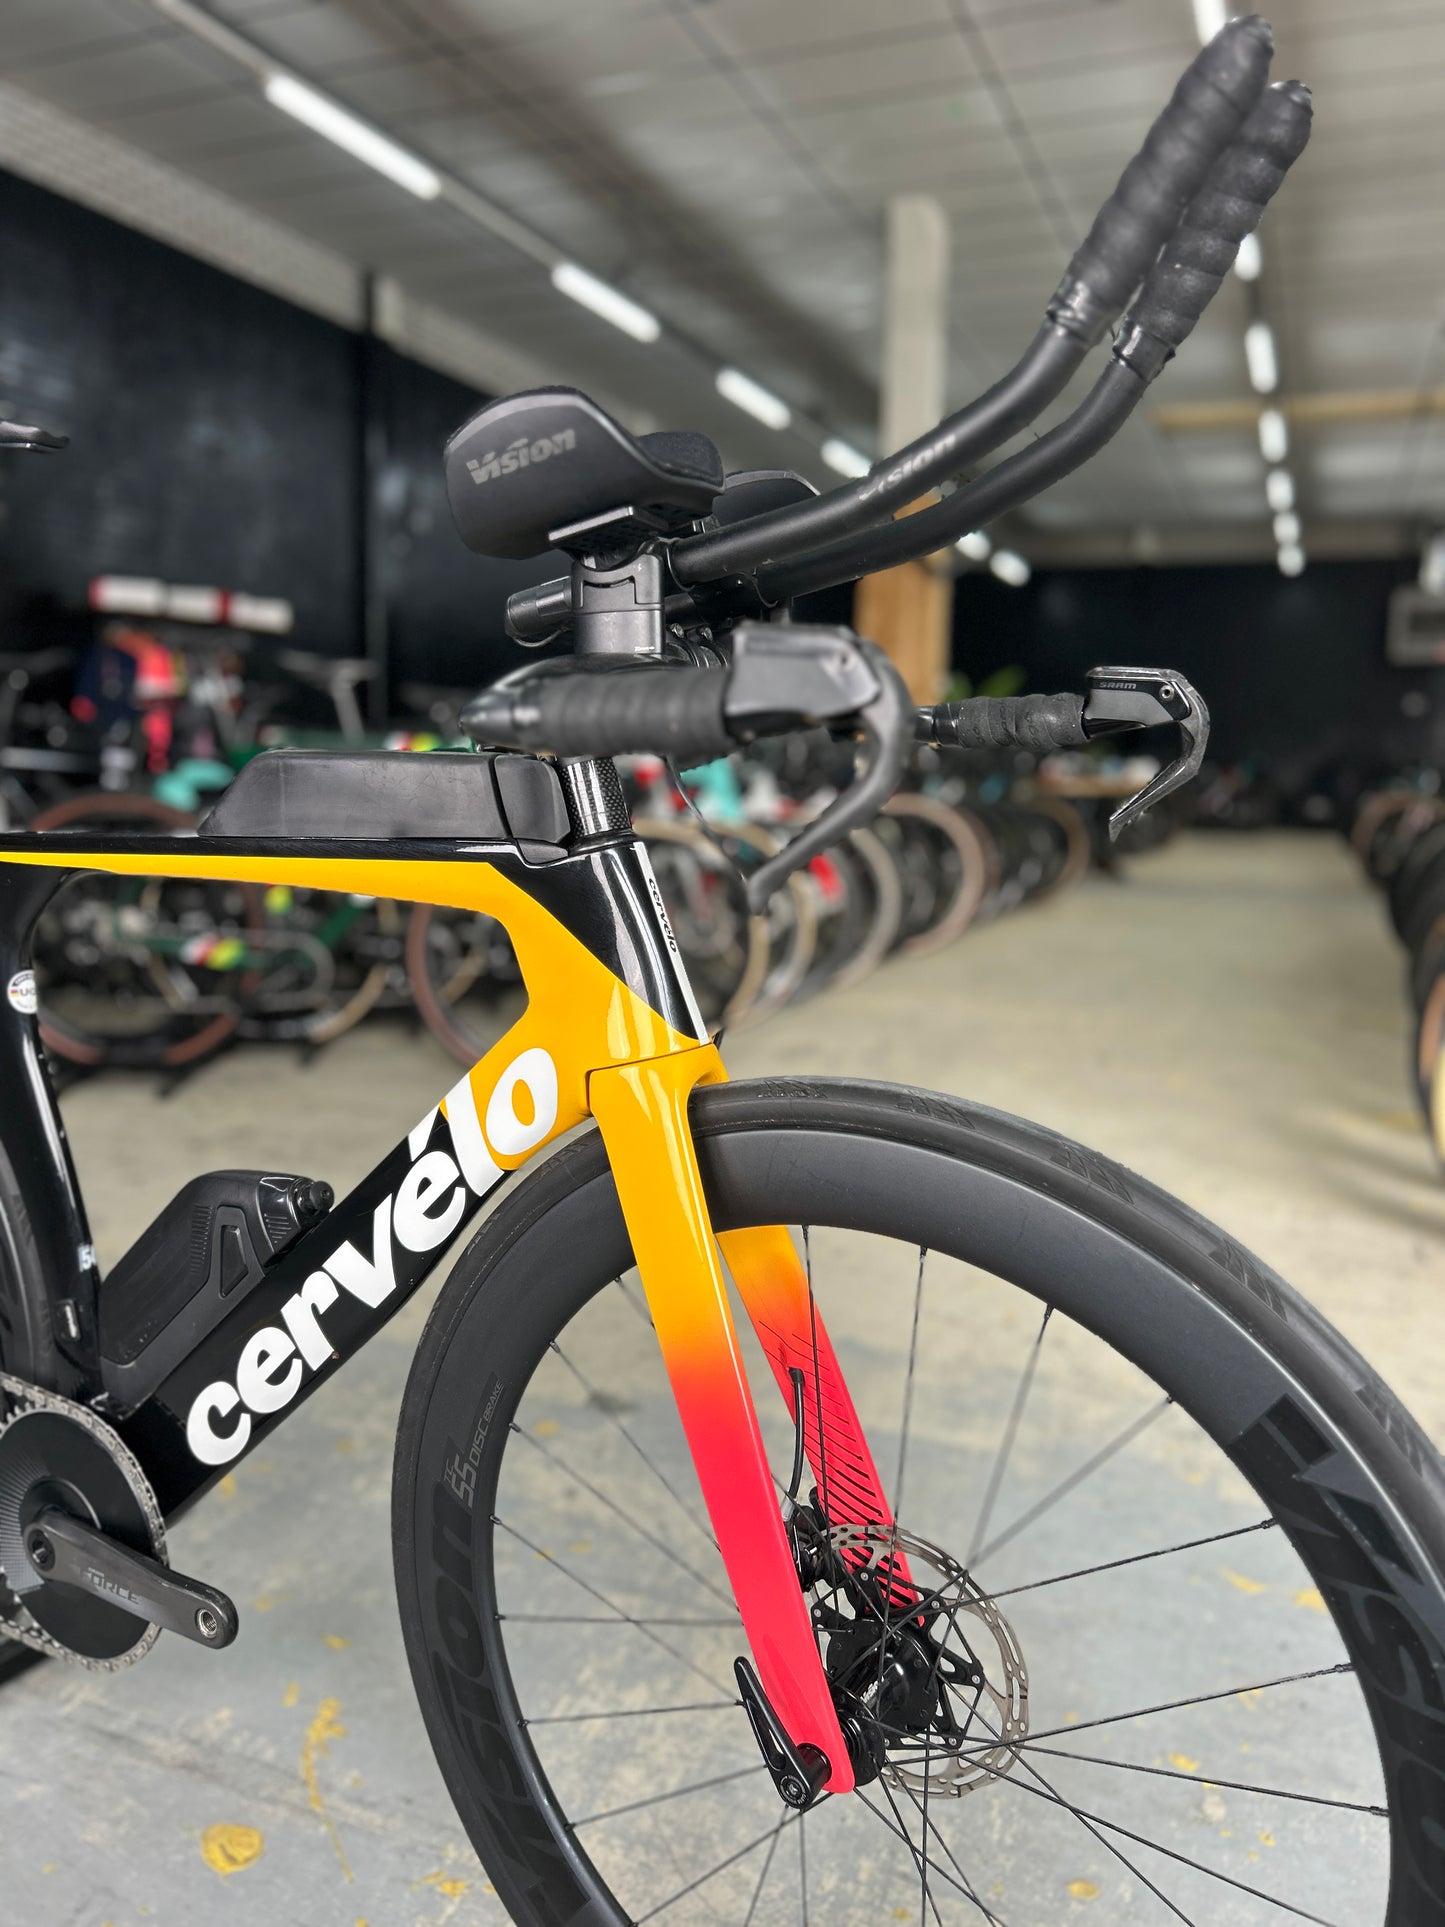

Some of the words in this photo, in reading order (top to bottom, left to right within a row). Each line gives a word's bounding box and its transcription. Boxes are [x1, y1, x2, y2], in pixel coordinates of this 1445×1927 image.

[465, 428, 577, 485] Vision
[1100, 681, 1137, 690] SRAM
[186, 1047, 558, 1466] cervélo
